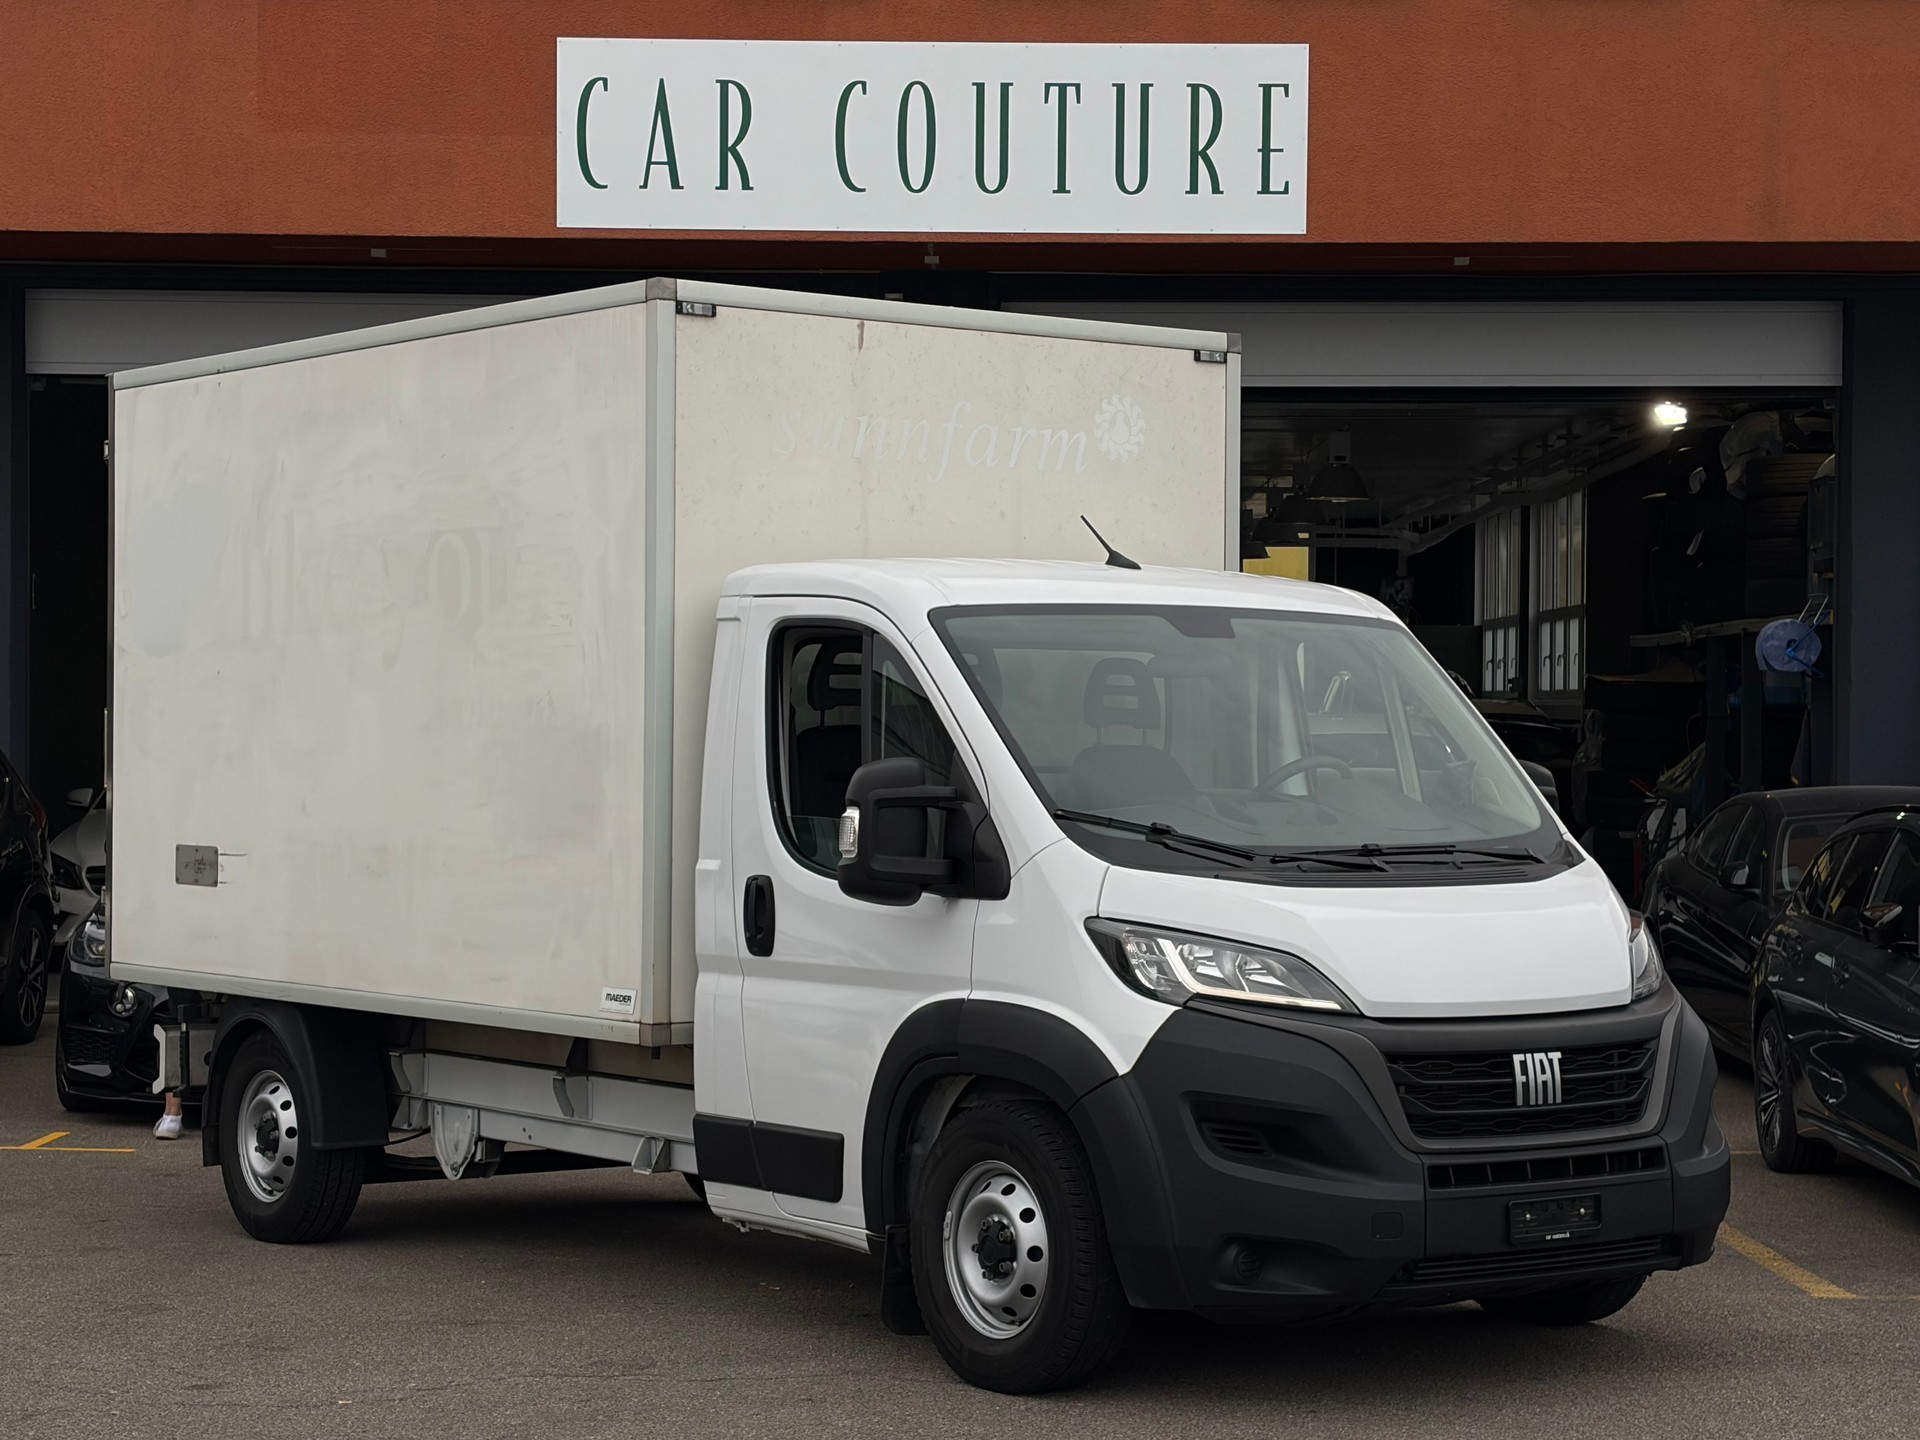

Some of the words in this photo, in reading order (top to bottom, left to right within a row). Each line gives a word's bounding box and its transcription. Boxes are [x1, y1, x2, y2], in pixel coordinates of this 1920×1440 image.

[577, 77, 753, 190] CAR
[836, 81, 1290, 195] COUTURE
[774, 400, 1088, 483] sunnfarm
[605, 992, 632, 1004] MAEDER
[1512, 1051, 1562, 1106] FIAT
